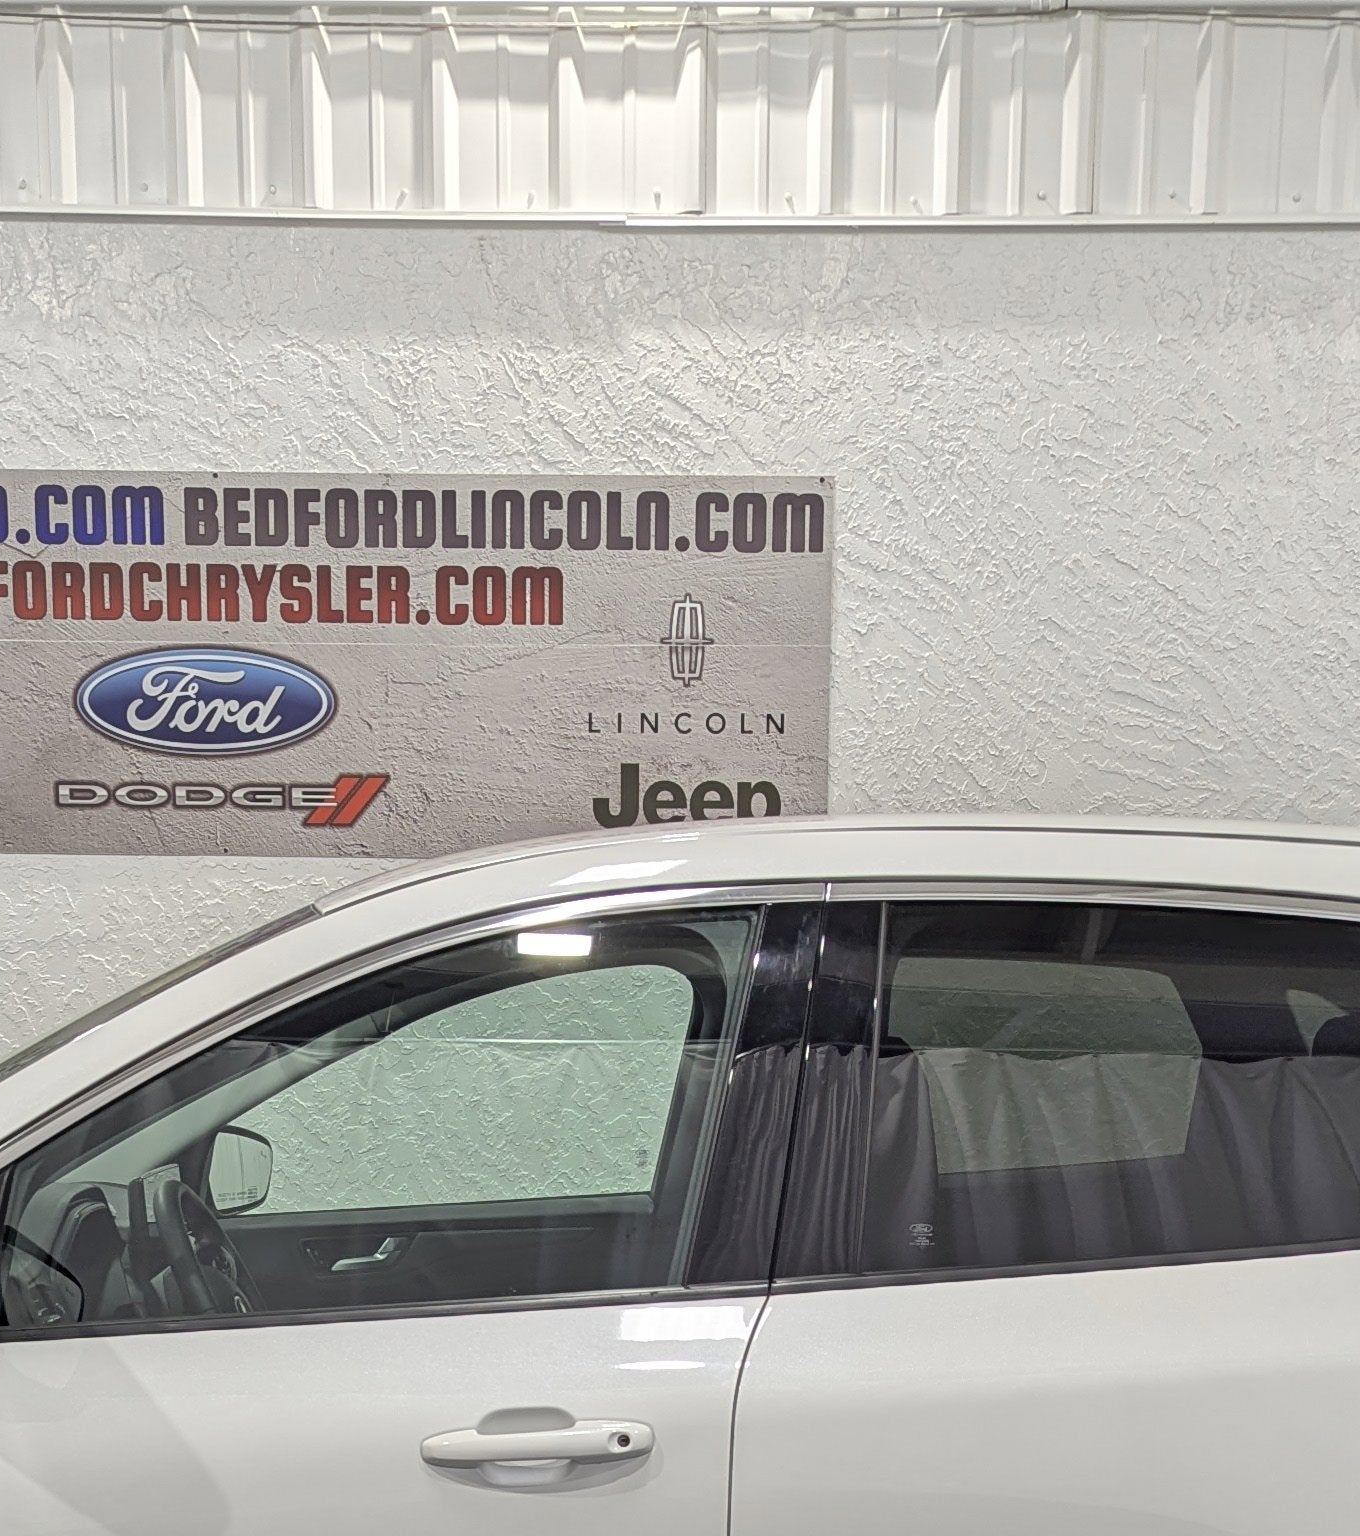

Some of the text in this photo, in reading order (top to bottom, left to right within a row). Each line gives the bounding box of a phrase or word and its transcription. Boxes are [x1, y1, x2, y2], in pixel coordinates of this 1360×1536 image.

[183, 486, 824, 554] BEDFORDLINCOLN.COM
[126, 665, 286, 734] Ford
[588, 712, 786, 735] LINCOLN
[57, 784, 338, 807] DODGE
